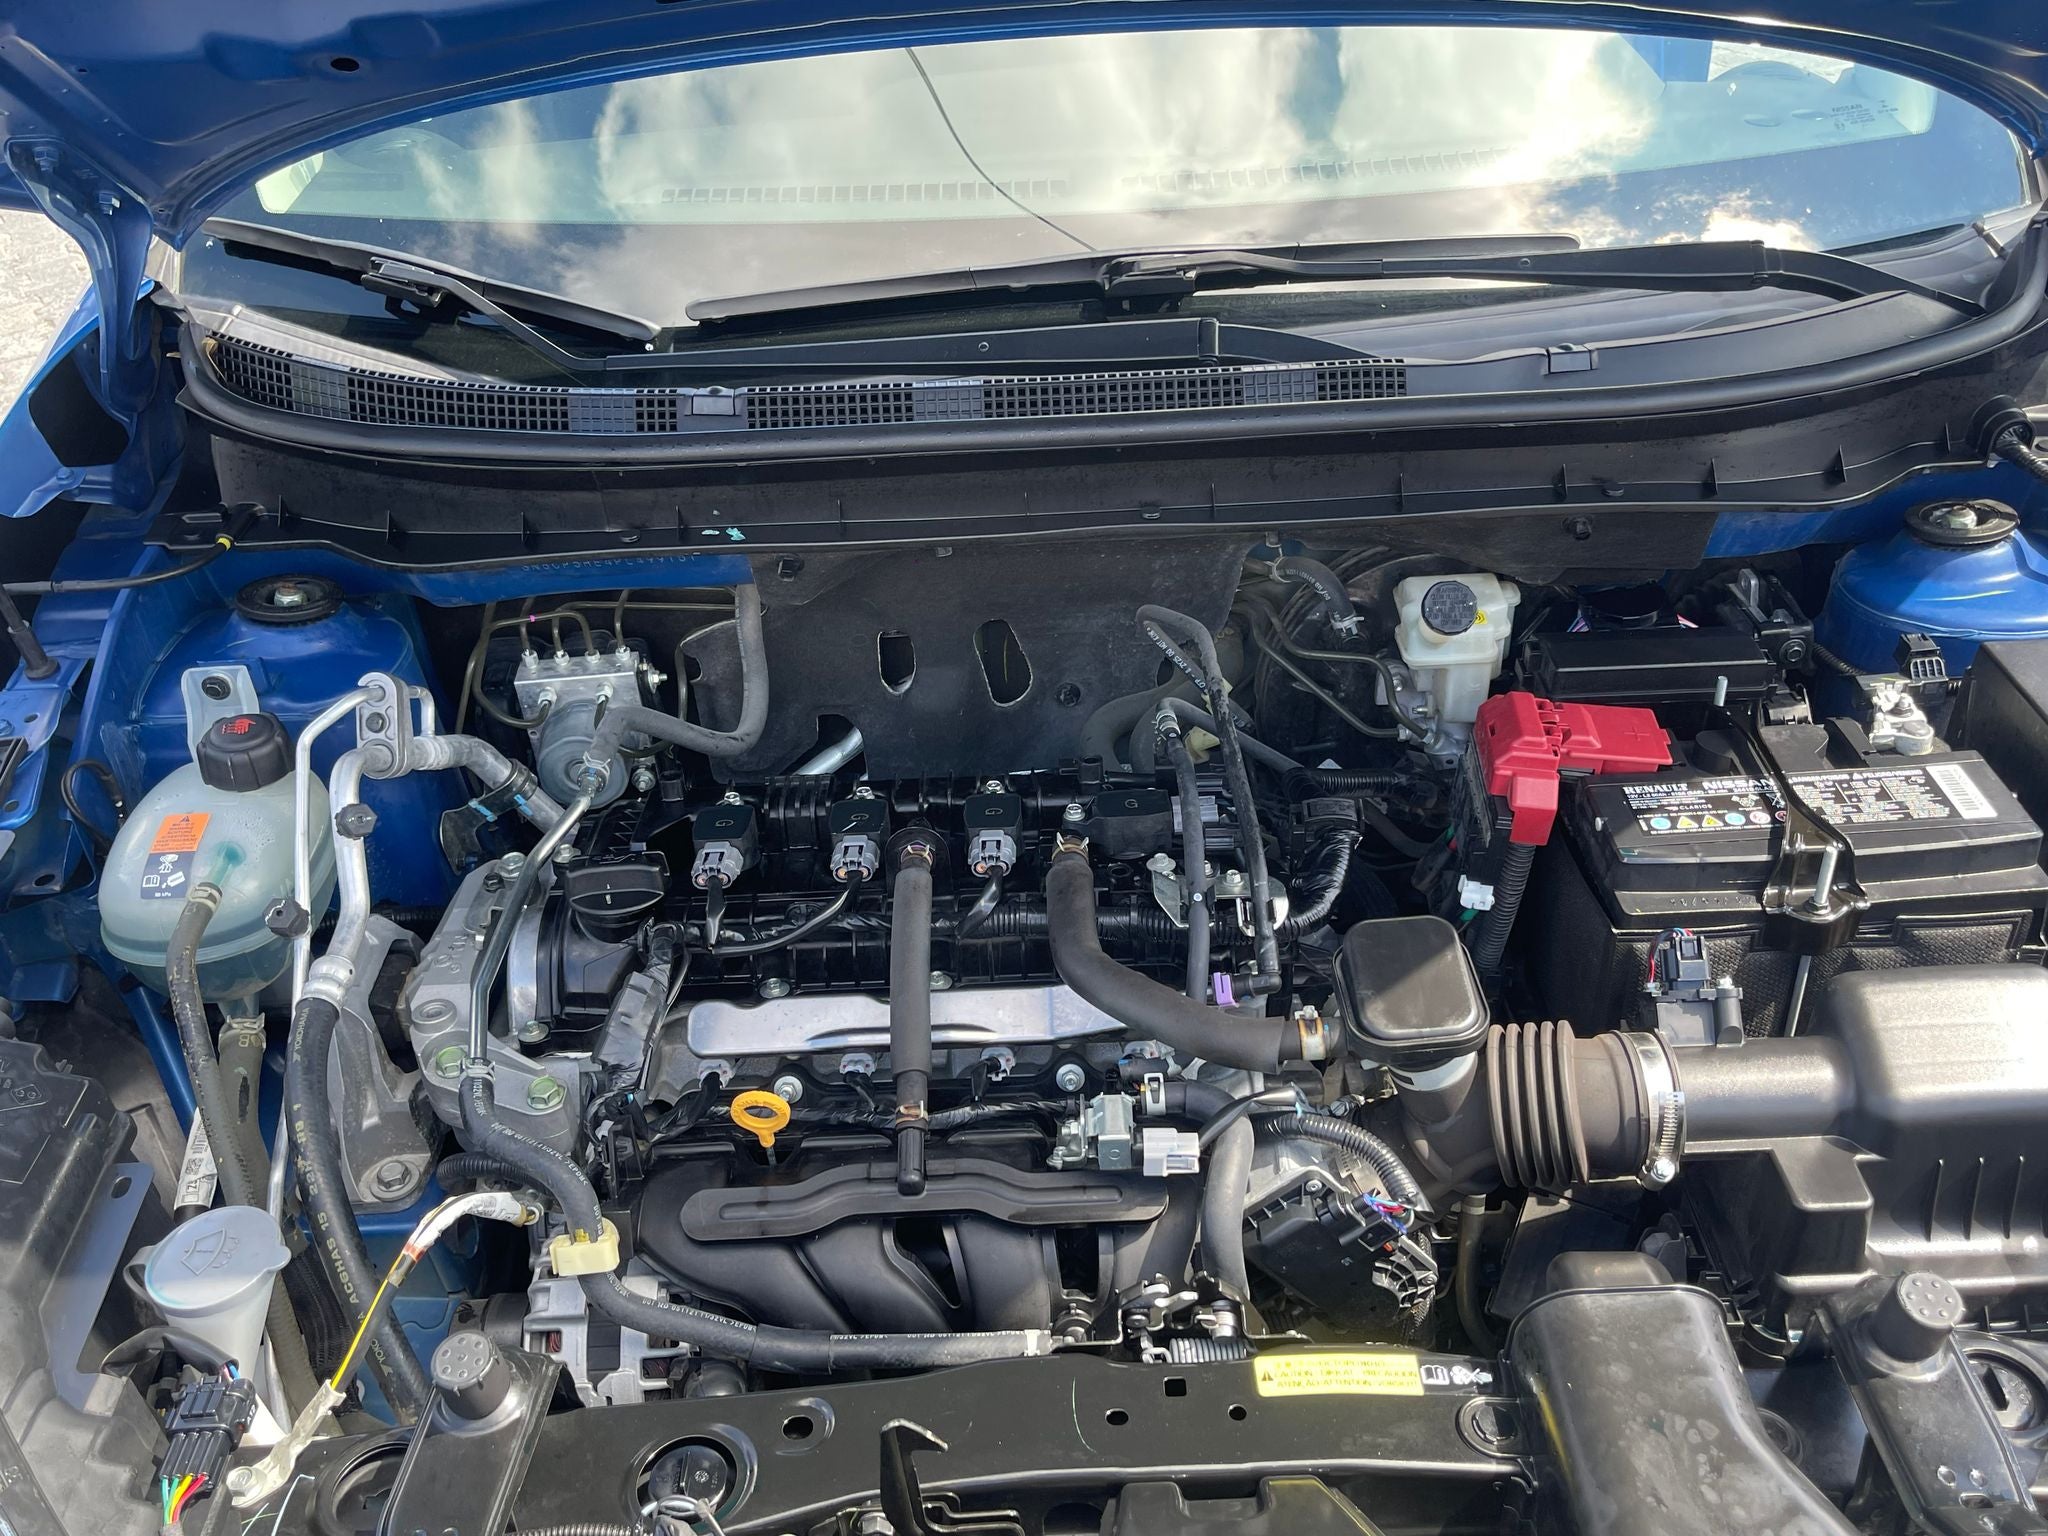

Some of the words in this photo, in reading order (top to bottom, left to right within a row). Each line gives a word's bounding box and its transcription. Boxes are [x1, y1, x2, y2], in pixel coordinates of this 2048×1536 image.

[1623, 783, 1688, 795] RENAULT
[1702, 777, 1776, 791] NISSAN
[294, 1007, 310, 1053] YOKOHAMA
[317, 1211, 329, 1231] 15
